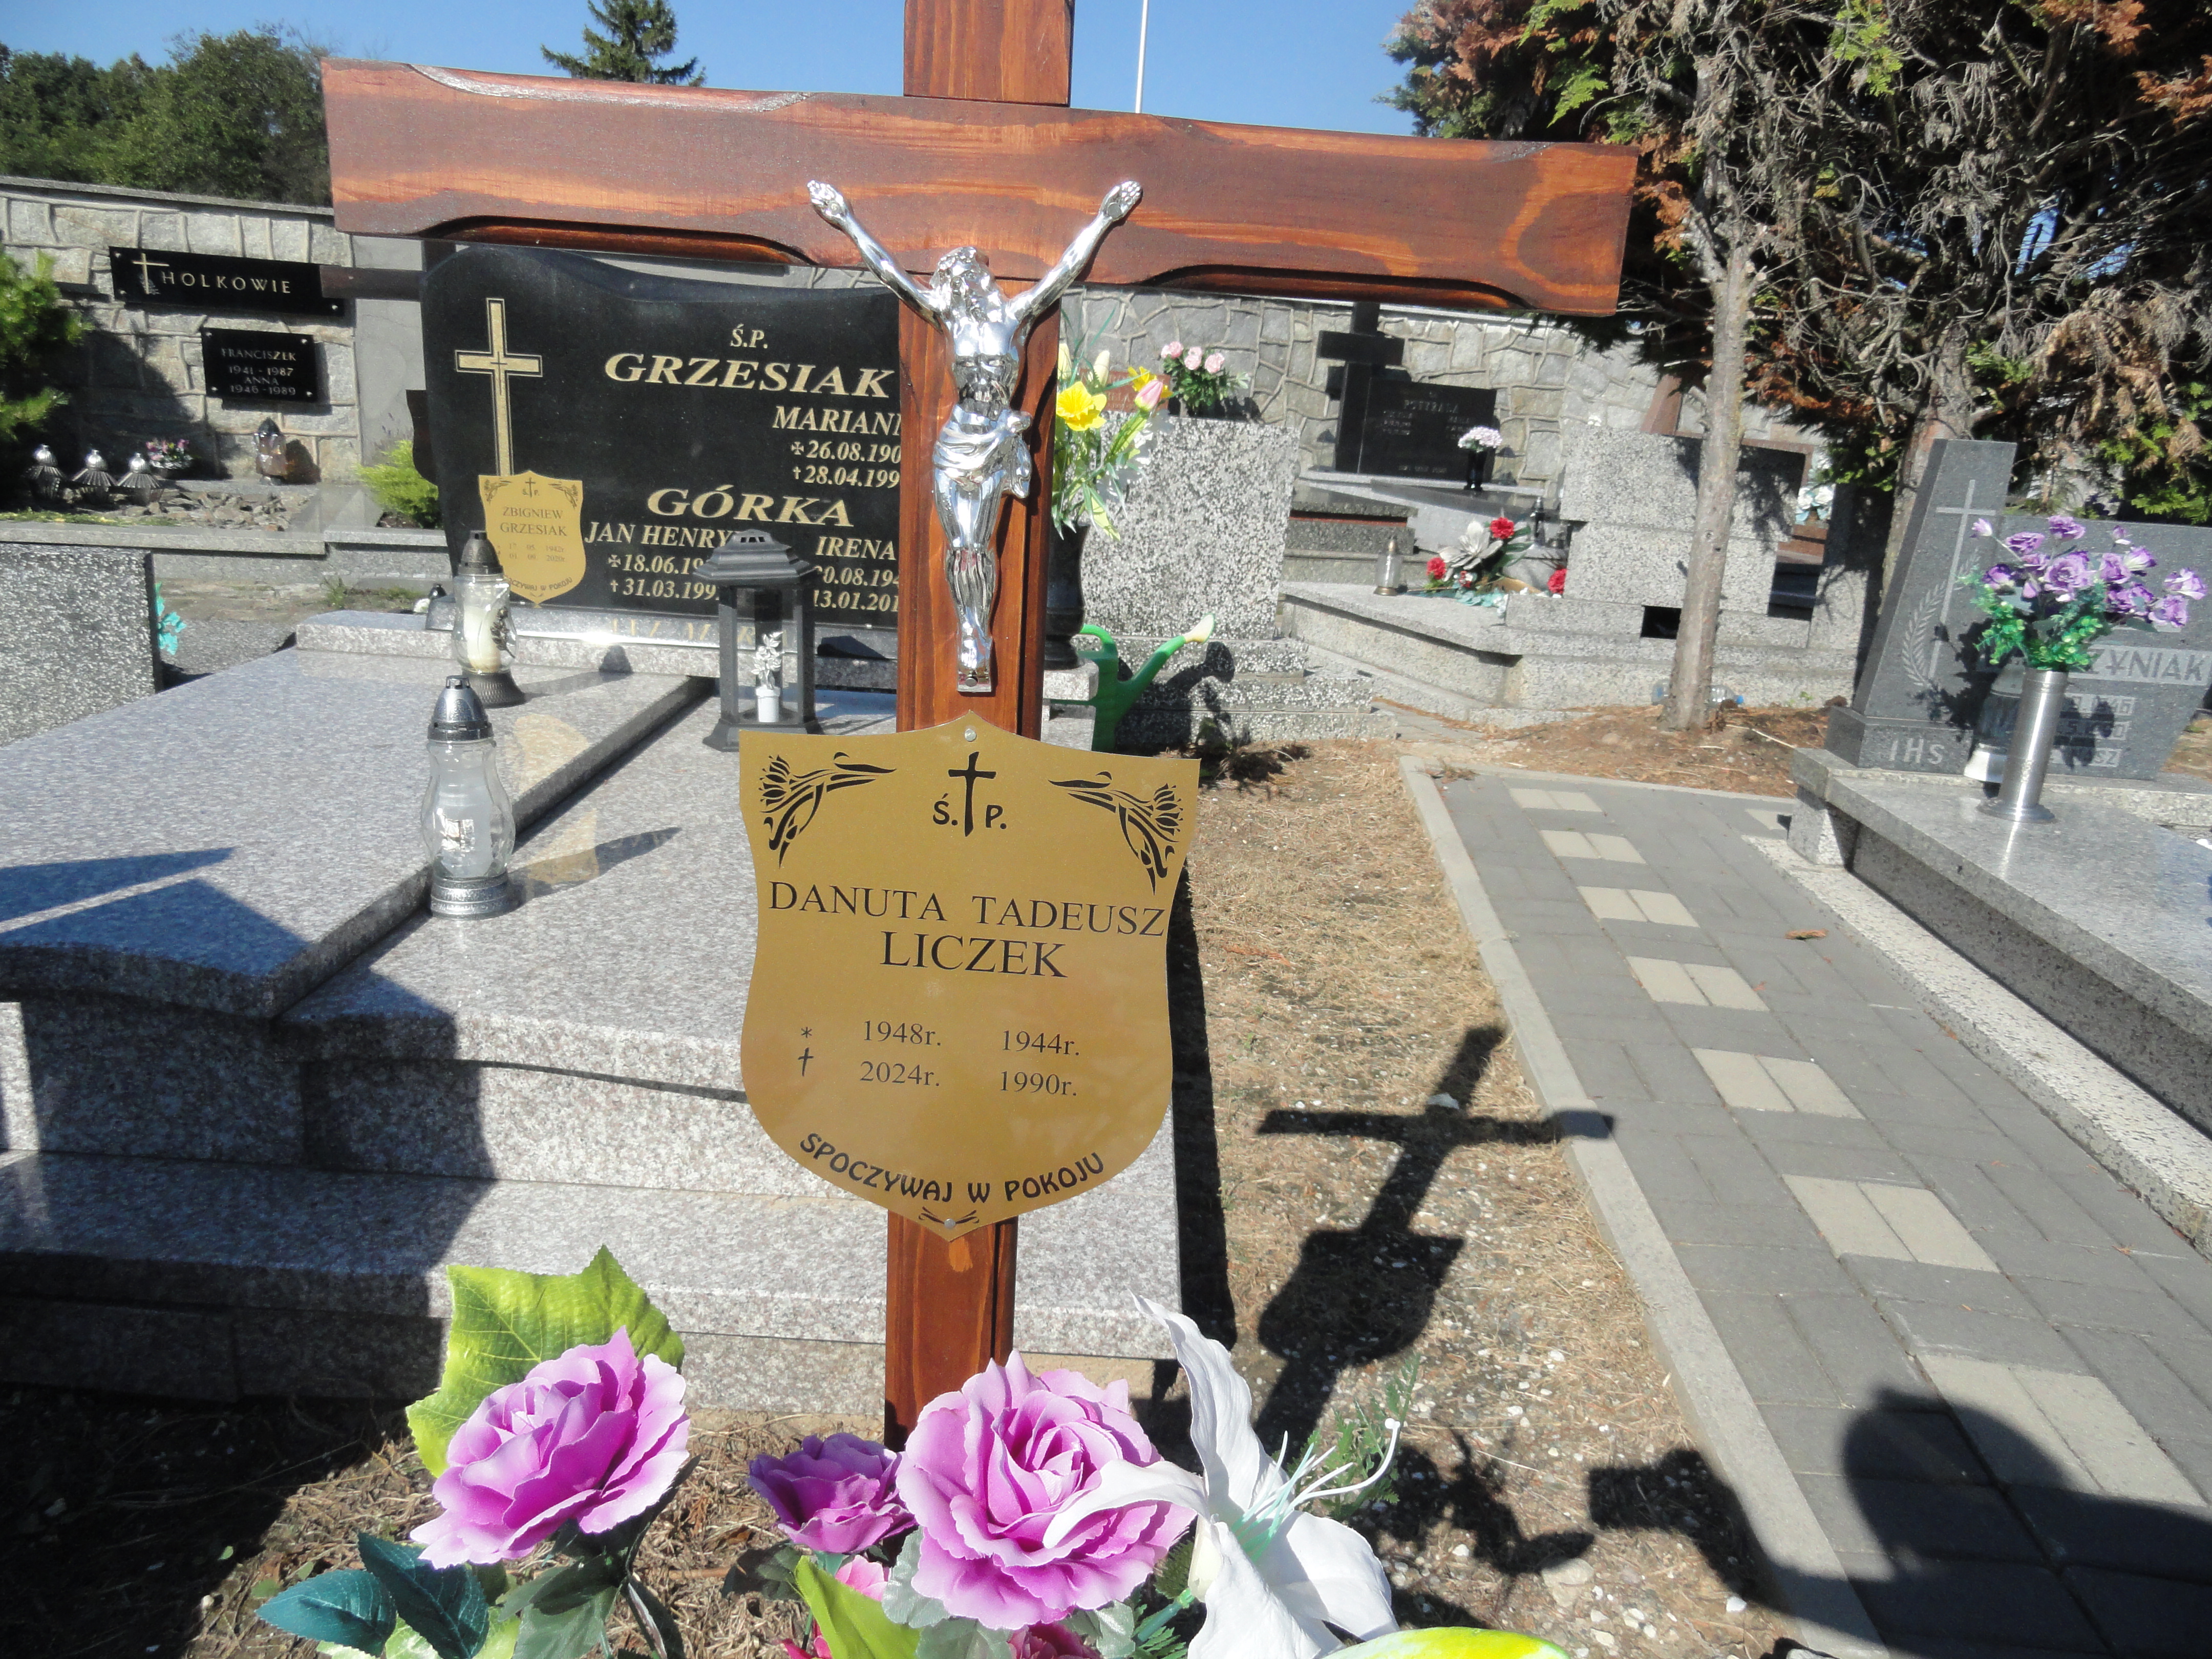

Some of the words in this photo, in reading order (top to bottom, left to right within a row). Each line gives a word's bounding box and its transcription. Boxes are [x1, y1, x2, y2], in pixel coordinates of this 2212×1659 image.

[161, 271, 291, 294] HOLKOWIE
[730, 324, 768, 348] Ś.P.
[221, 348, 296, 361] FRANCISZEK
[244, 376, 279, 386] ANNA
[267, 368, 294, 376] 1987
[605, 353, 895, 399] GRZESIAK
[269, 387, 296, 396] 1989
[806, 440, 901, 464] 26.08.190
[804, 465, 900, 488] 28.04.199
[503, 506, 563, 519] ZBIGNIEW
[647, 485, 854, 527] GÓRKA
[500, 522, 567, 536] GRZESIAK
[584, 522, 636, 544] JAN
[641, 525, 735, 548] HENRY
[815, 536, 897, 561] IRENA
[622, 554, 705, 575] 18.06.19
[548, 577, 572, 590] POKOJU
[623, 577, 719, 601] 31.03.199
[813, 589, 899, 612] 13.01.201
[1888, 738, 1945, 764] IHS
[769, 881, 946, 922] DANUTA
[972, 896, 1165, 937] TADEUSZ
[880, 931, 1068, 978] LICZEK
[863, 1020, 942, 1046] 1948r.
[1002, 1029, 1080, 1056] 1944r.
[860, 1060, 940, 1087] 2024r.
[999, 1070, 1079, 1097] 1990r.
[799, 1133, 953, 1202] SPOCZYWAJ
[967, 1182, 991, 1203] W
[1005, 1152, 1104, 1202] POKOJU
